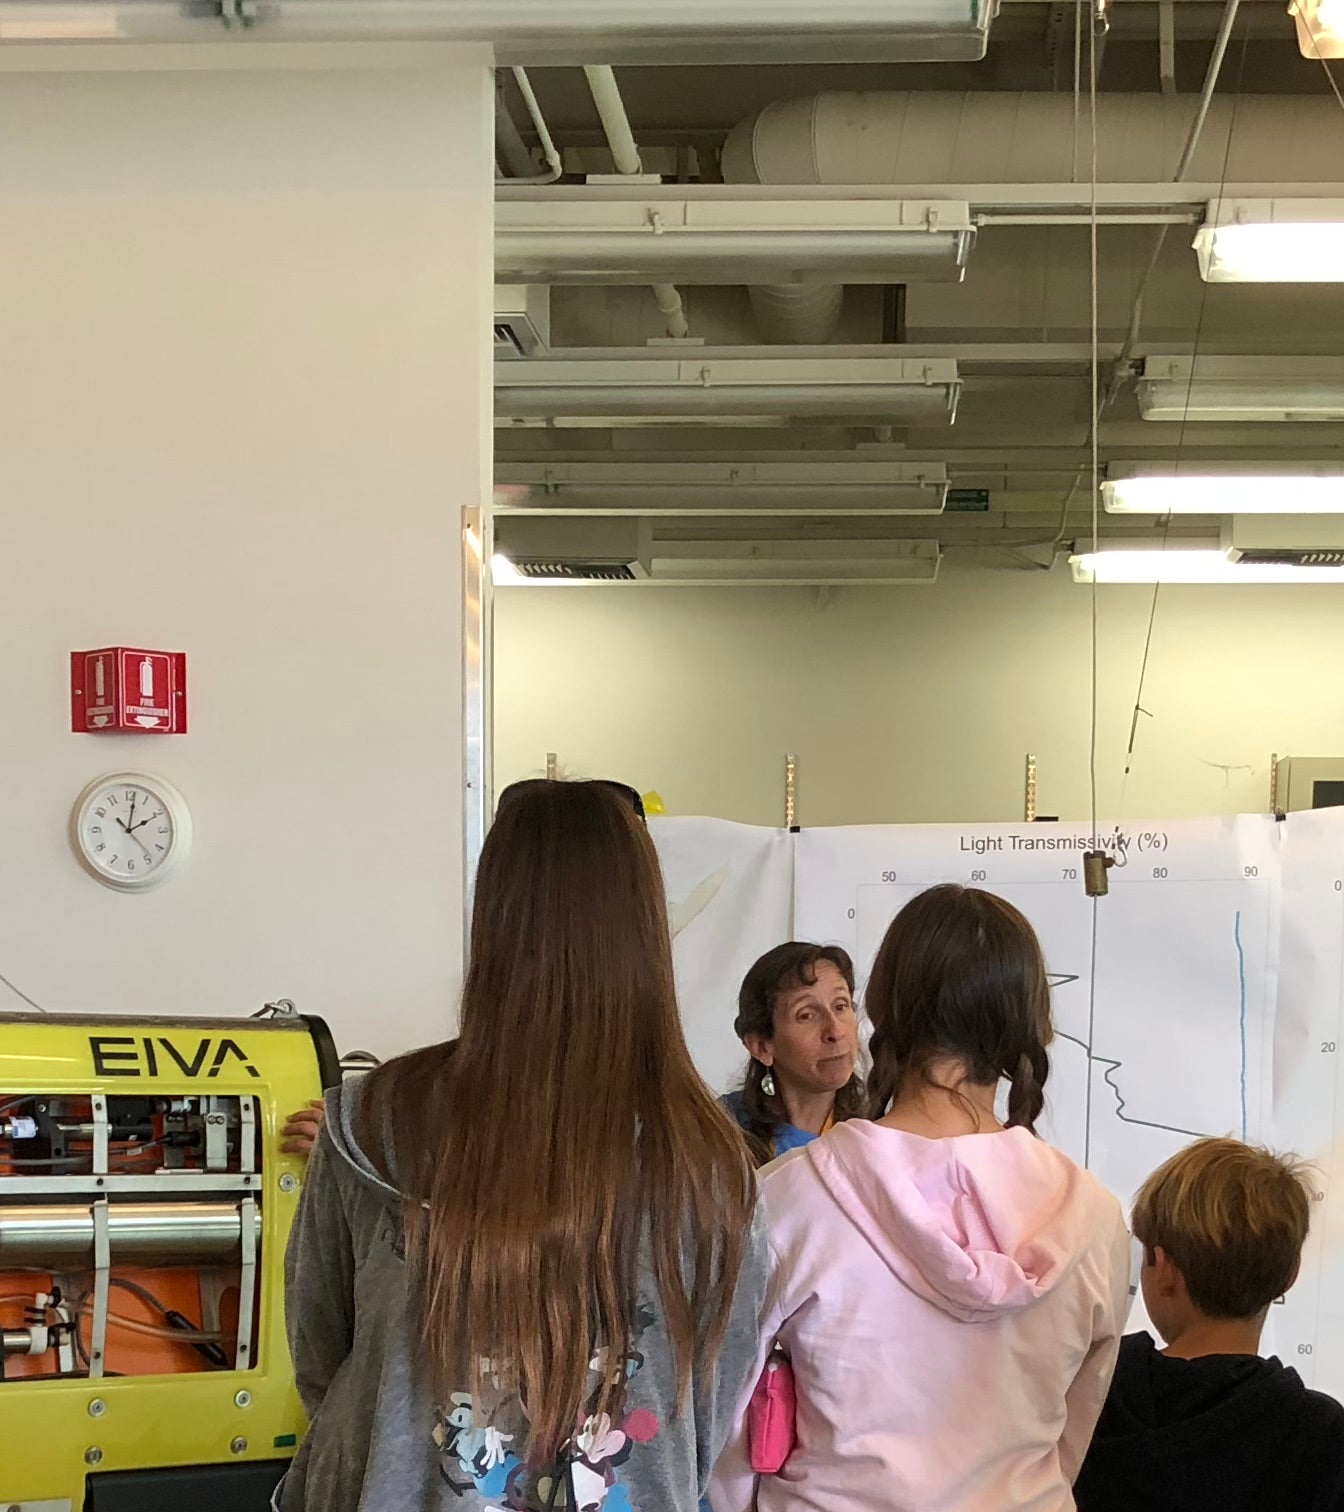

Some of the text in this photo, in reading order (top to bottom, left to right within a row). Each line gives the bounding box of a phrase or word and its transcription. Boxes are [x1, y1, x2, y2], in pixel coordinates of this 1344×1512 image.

[960, 835, 1002, 854] Light
[1137, 832, 1168, 853] (%)
[881, 865, 1258, 882] 50 60 70 80 90
[1334, 881, 1342, 891] 0
[1321, 1042, 1336, 1053] 20
[89, 1037, 261, 1077] EIVA
[1298, 1344, 1312, 1354] 60
